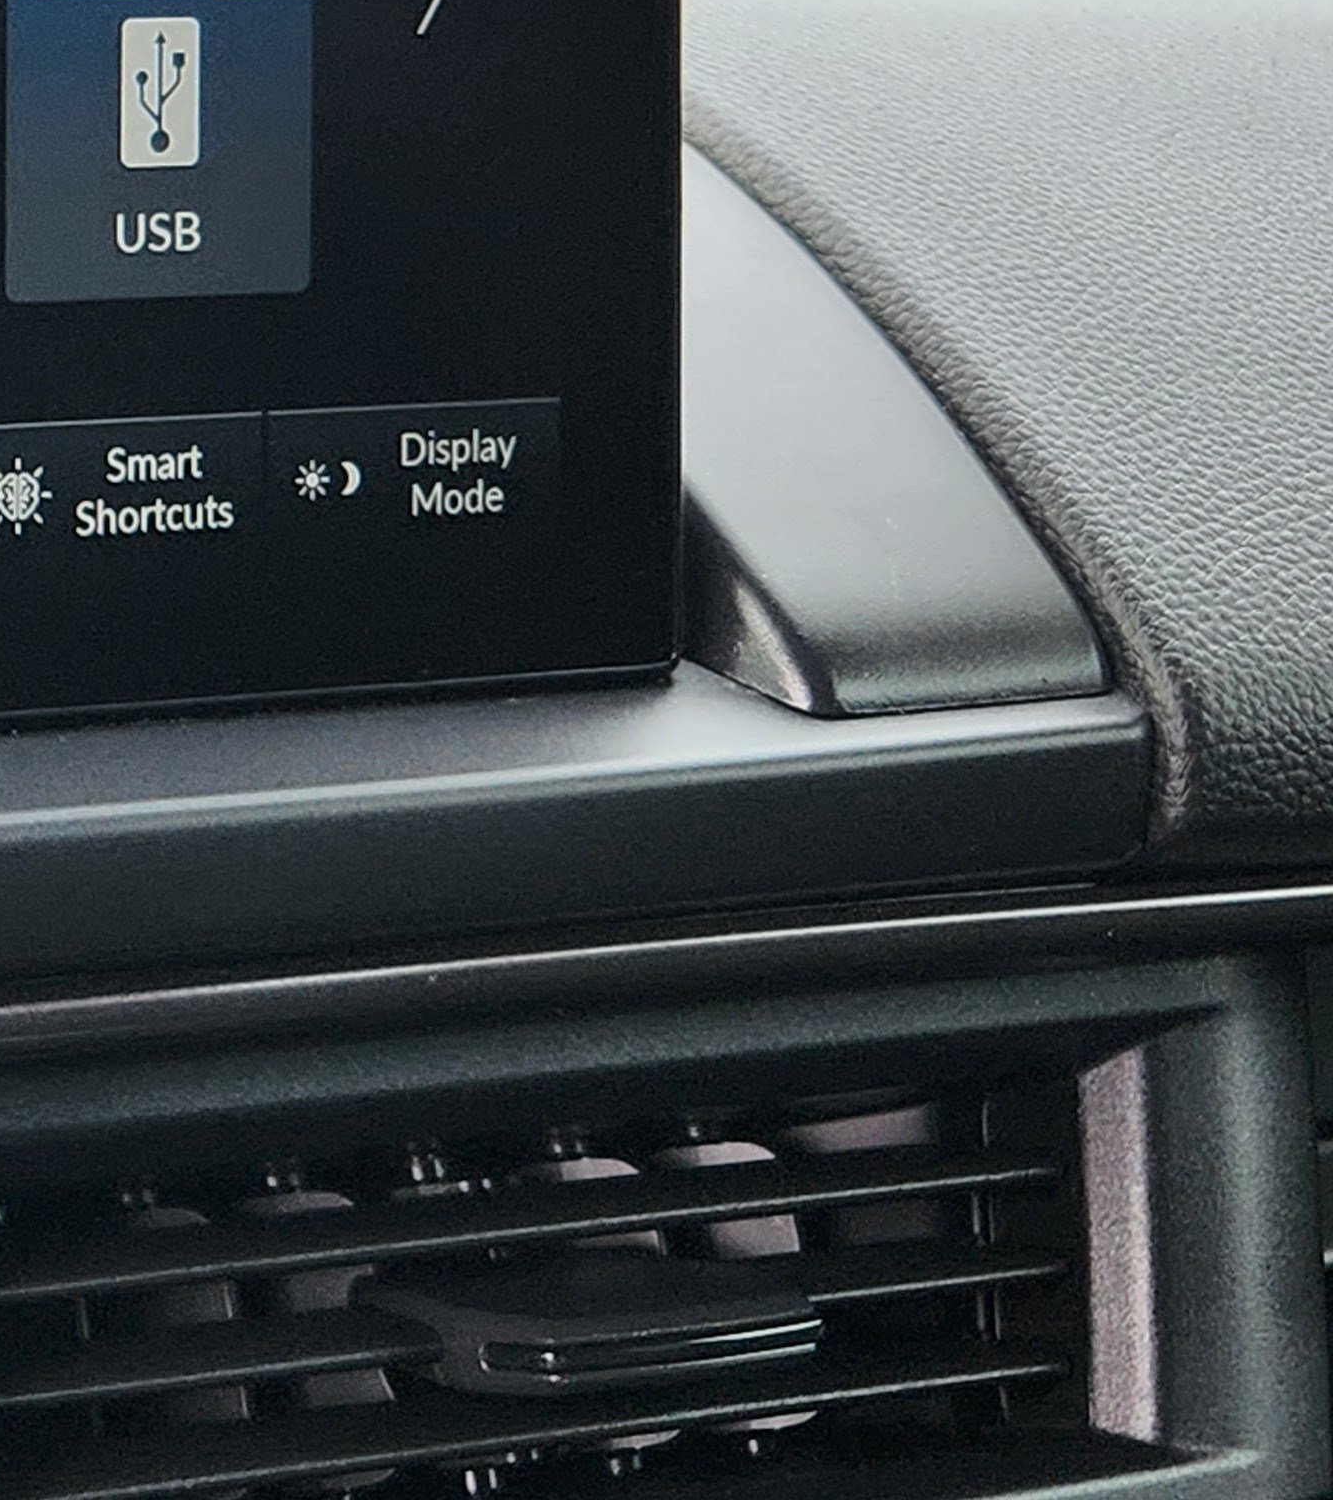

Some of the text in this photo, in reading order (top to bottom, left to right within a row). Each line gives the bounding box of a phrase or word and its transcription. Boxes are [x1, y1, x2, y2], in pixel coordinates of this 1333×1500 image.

[115, 210, 202, 255] USB
[105, 443, 204, 484] Smart
[400, 427, 518, 473] Display
[74, 494, 235, 538] Shortcuts
[410, 477, 505, 518] Mode
